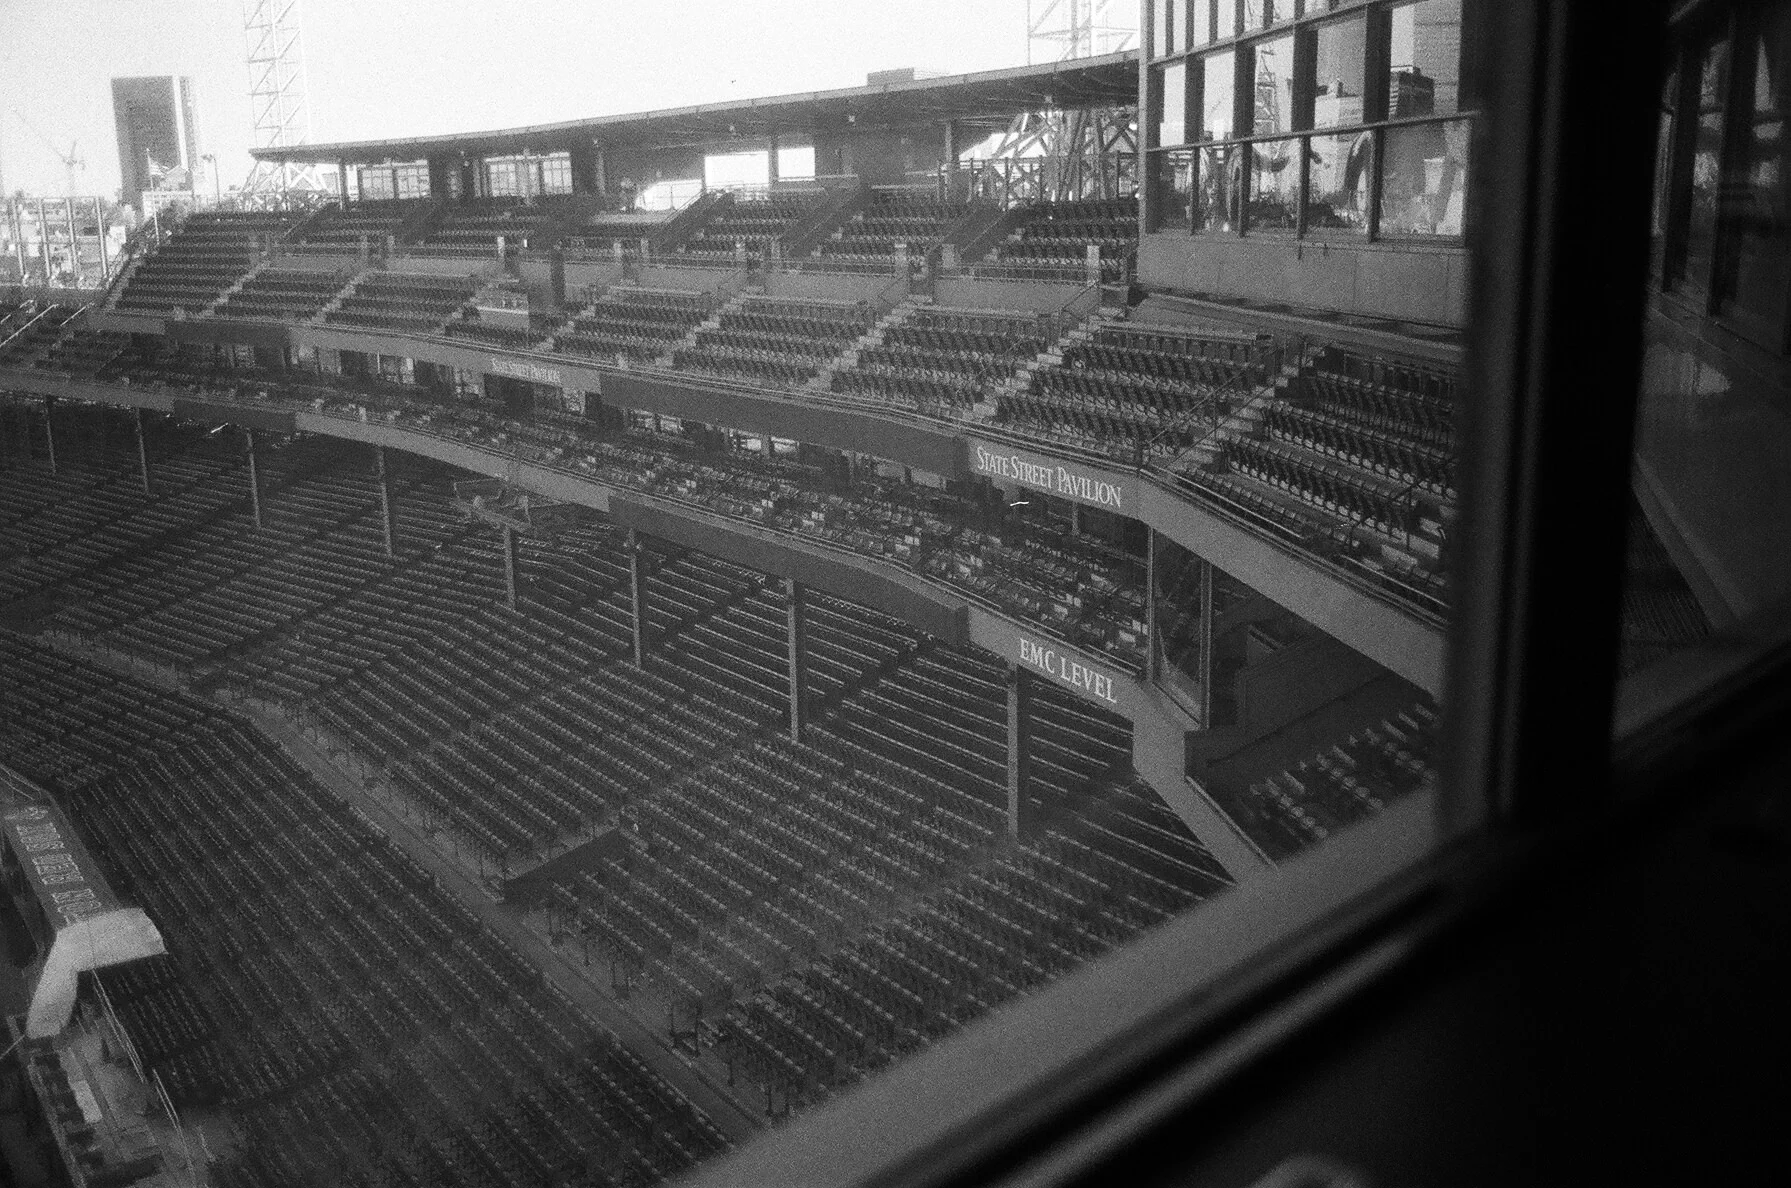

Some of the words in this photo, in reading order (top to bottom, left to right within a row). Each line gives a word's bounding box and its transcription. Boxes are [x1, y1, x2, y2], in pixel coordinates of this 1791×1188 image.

[977, 446, 1009, 477] STATE
[1010, 456, 1053, 488] STREET
[1057, 466, 1122, 508] PAVILION
[1020, 637, 1055, 674] EMC
[1060, 655, 1117, 704] LEVEL
